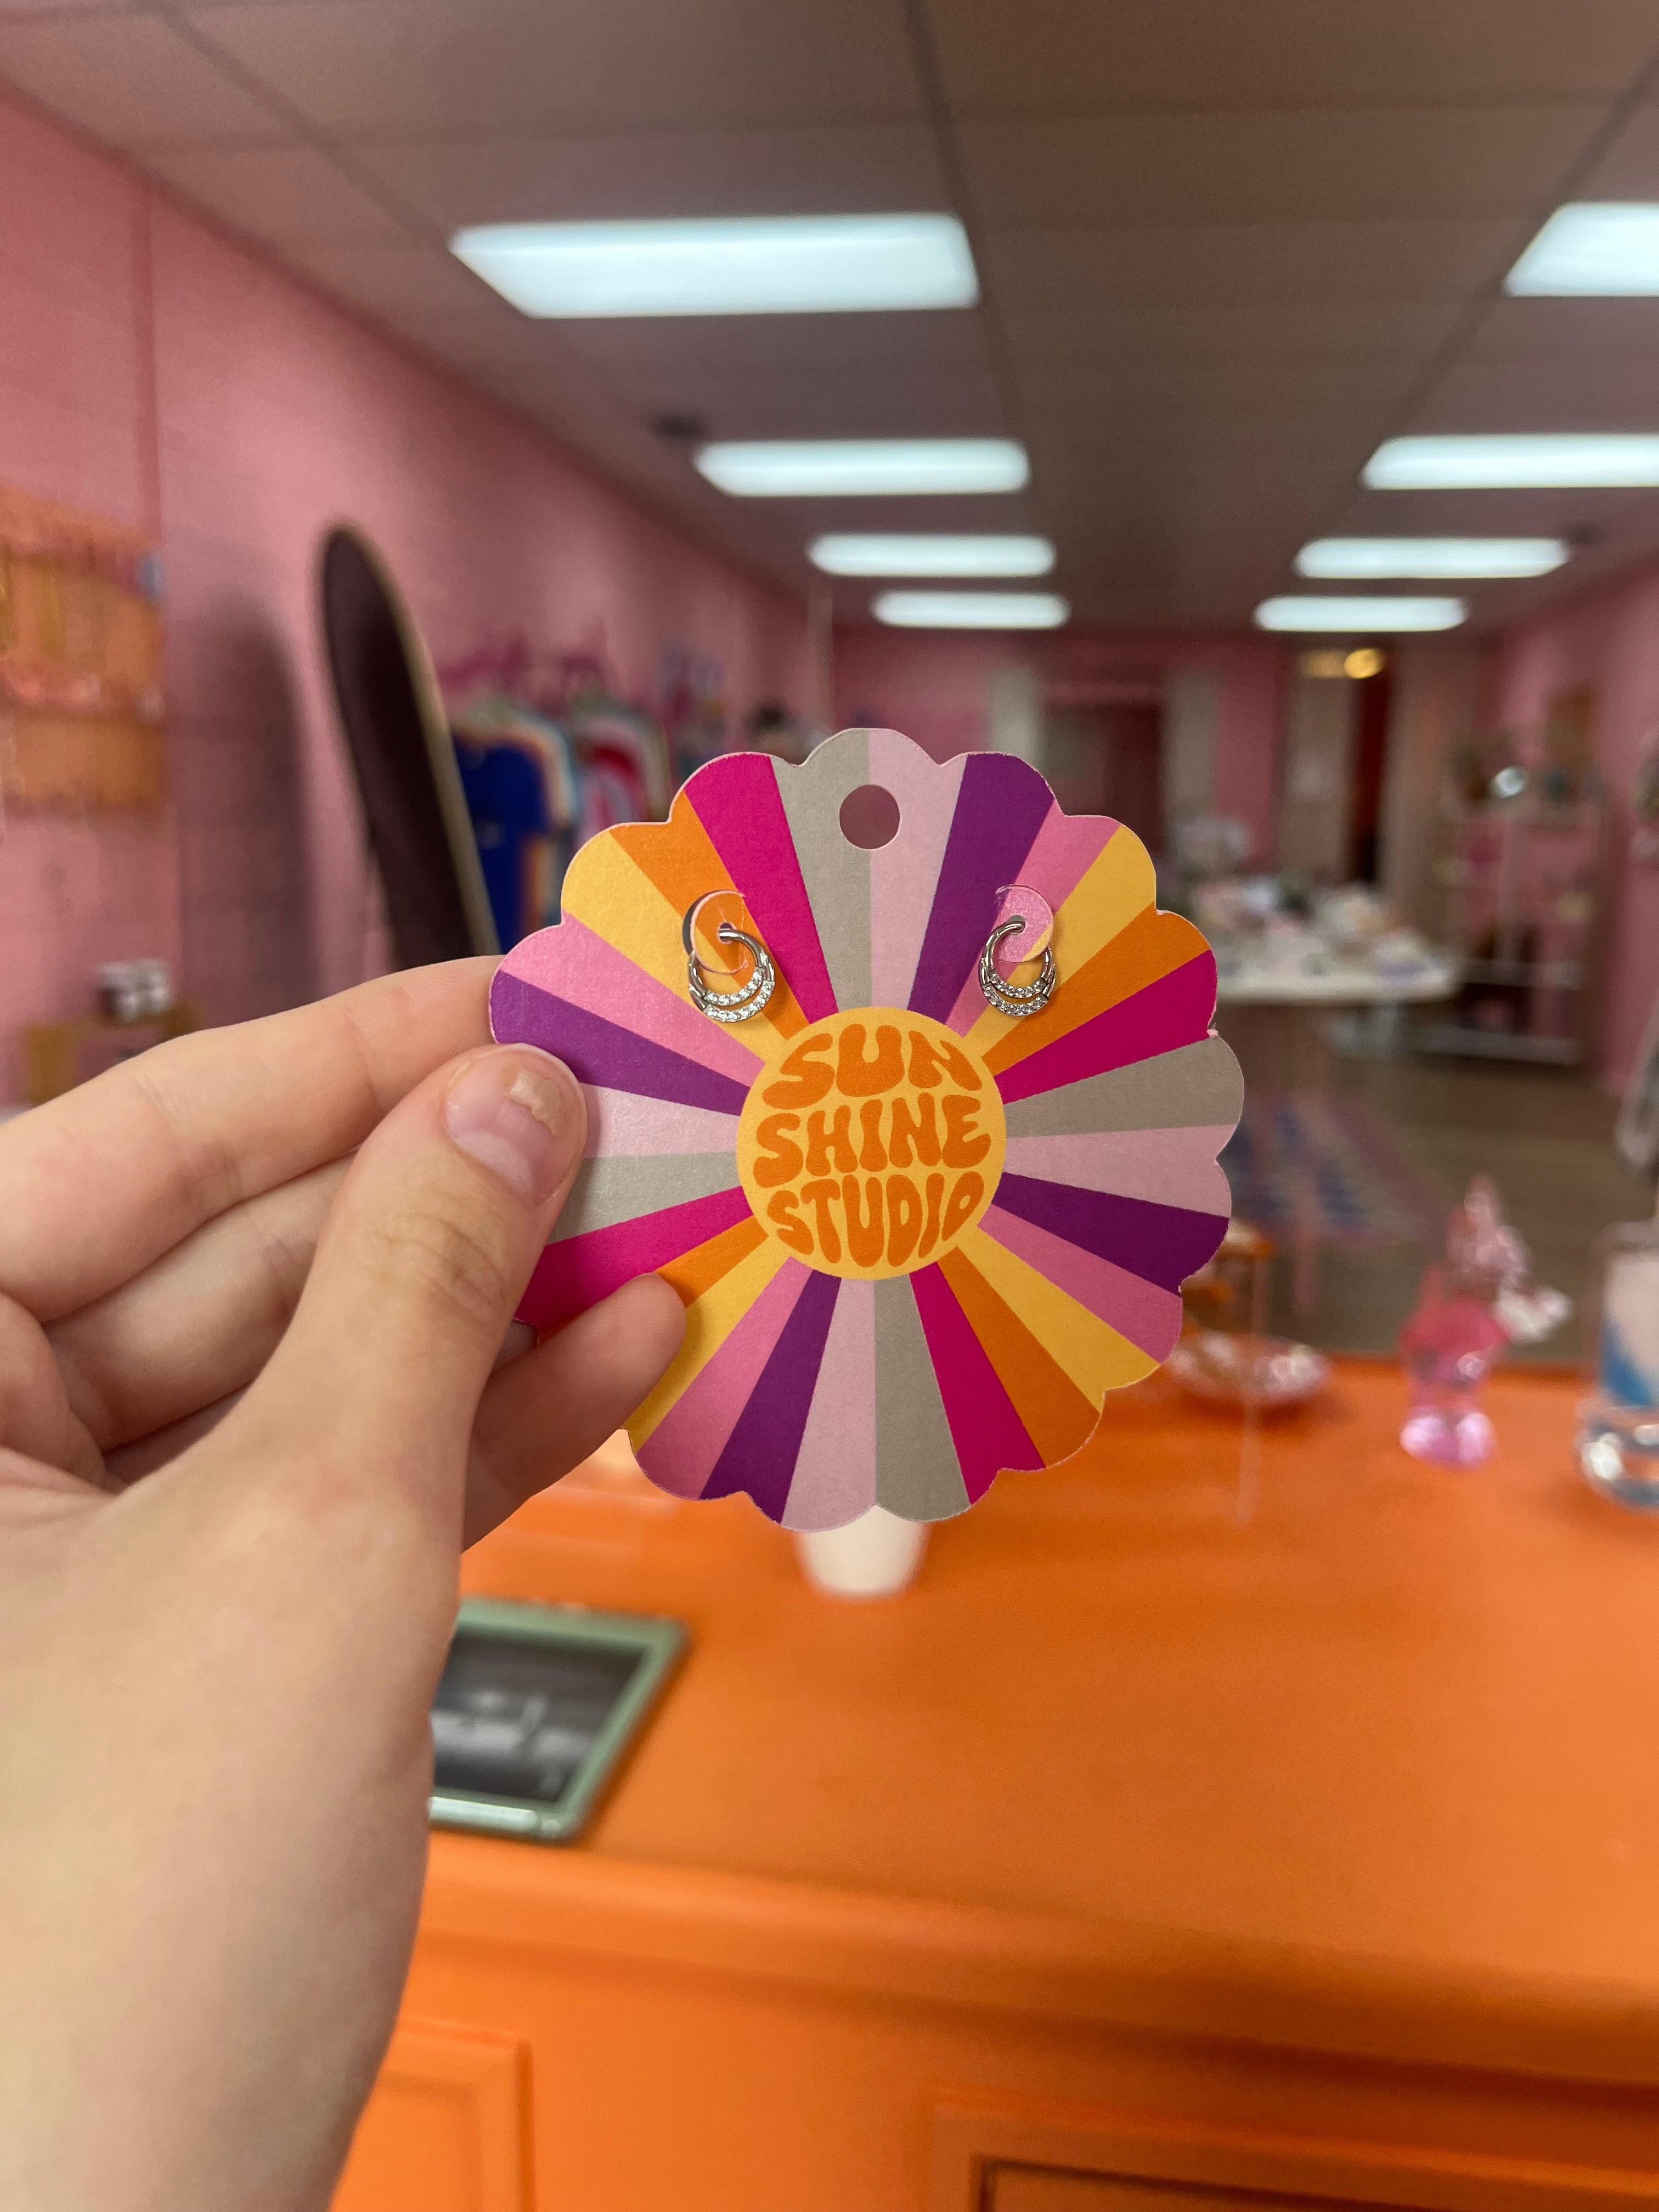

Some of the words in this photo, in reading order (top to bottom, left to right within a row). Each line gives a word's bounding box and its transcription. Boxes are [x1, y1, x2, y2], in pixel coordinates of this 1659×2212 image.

[762, 1024, 983, 1109] SUN
[753, 1092, 991, 1188] SHINE
[767, 1171, 984, 1267] STUDIO
